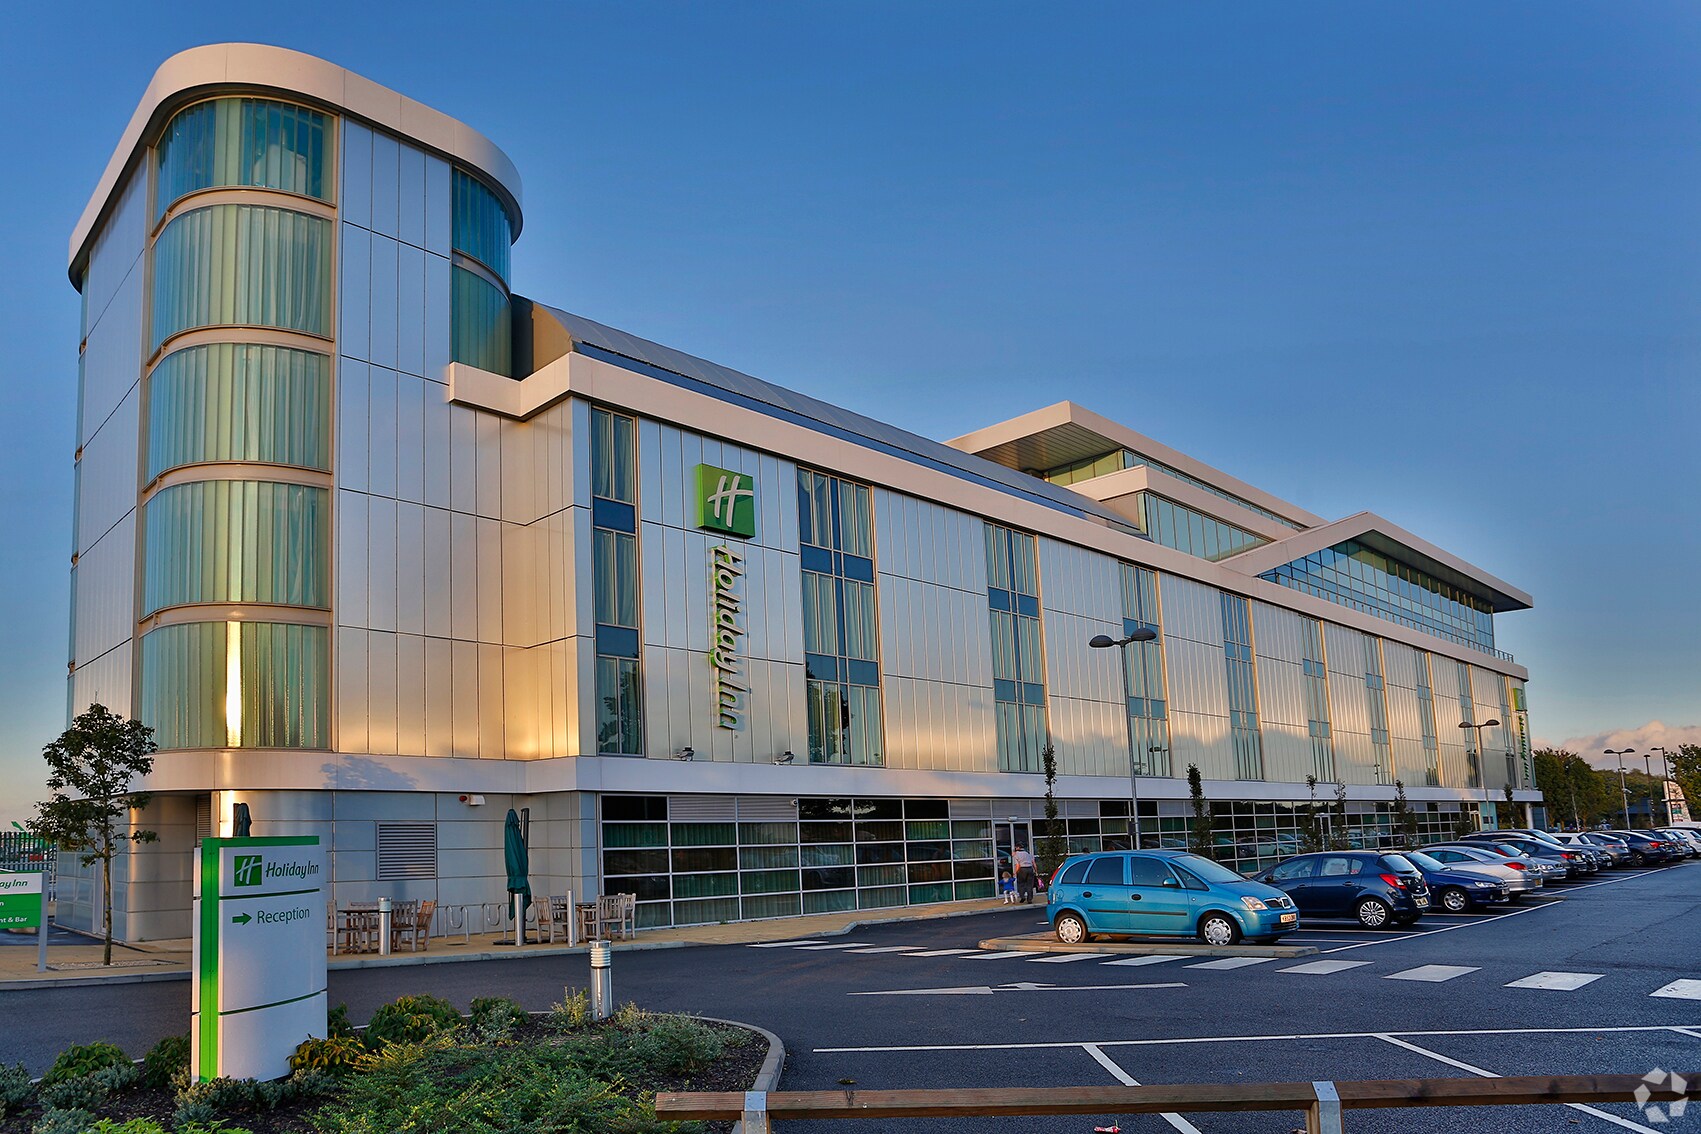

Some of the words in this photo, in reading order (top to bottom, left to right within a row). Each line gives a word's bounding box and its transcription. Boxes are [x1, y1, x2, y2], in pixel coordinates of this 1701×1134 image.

[712, 545, 745, 674] Holiday
[719, 677, 749, 731] Inn
[265, 861, 307, 880] Holiday
[307, 860, 319, 875] Inn
[12, 879, 28, 887] Inn
[257, 906, 310, 925] Reception
